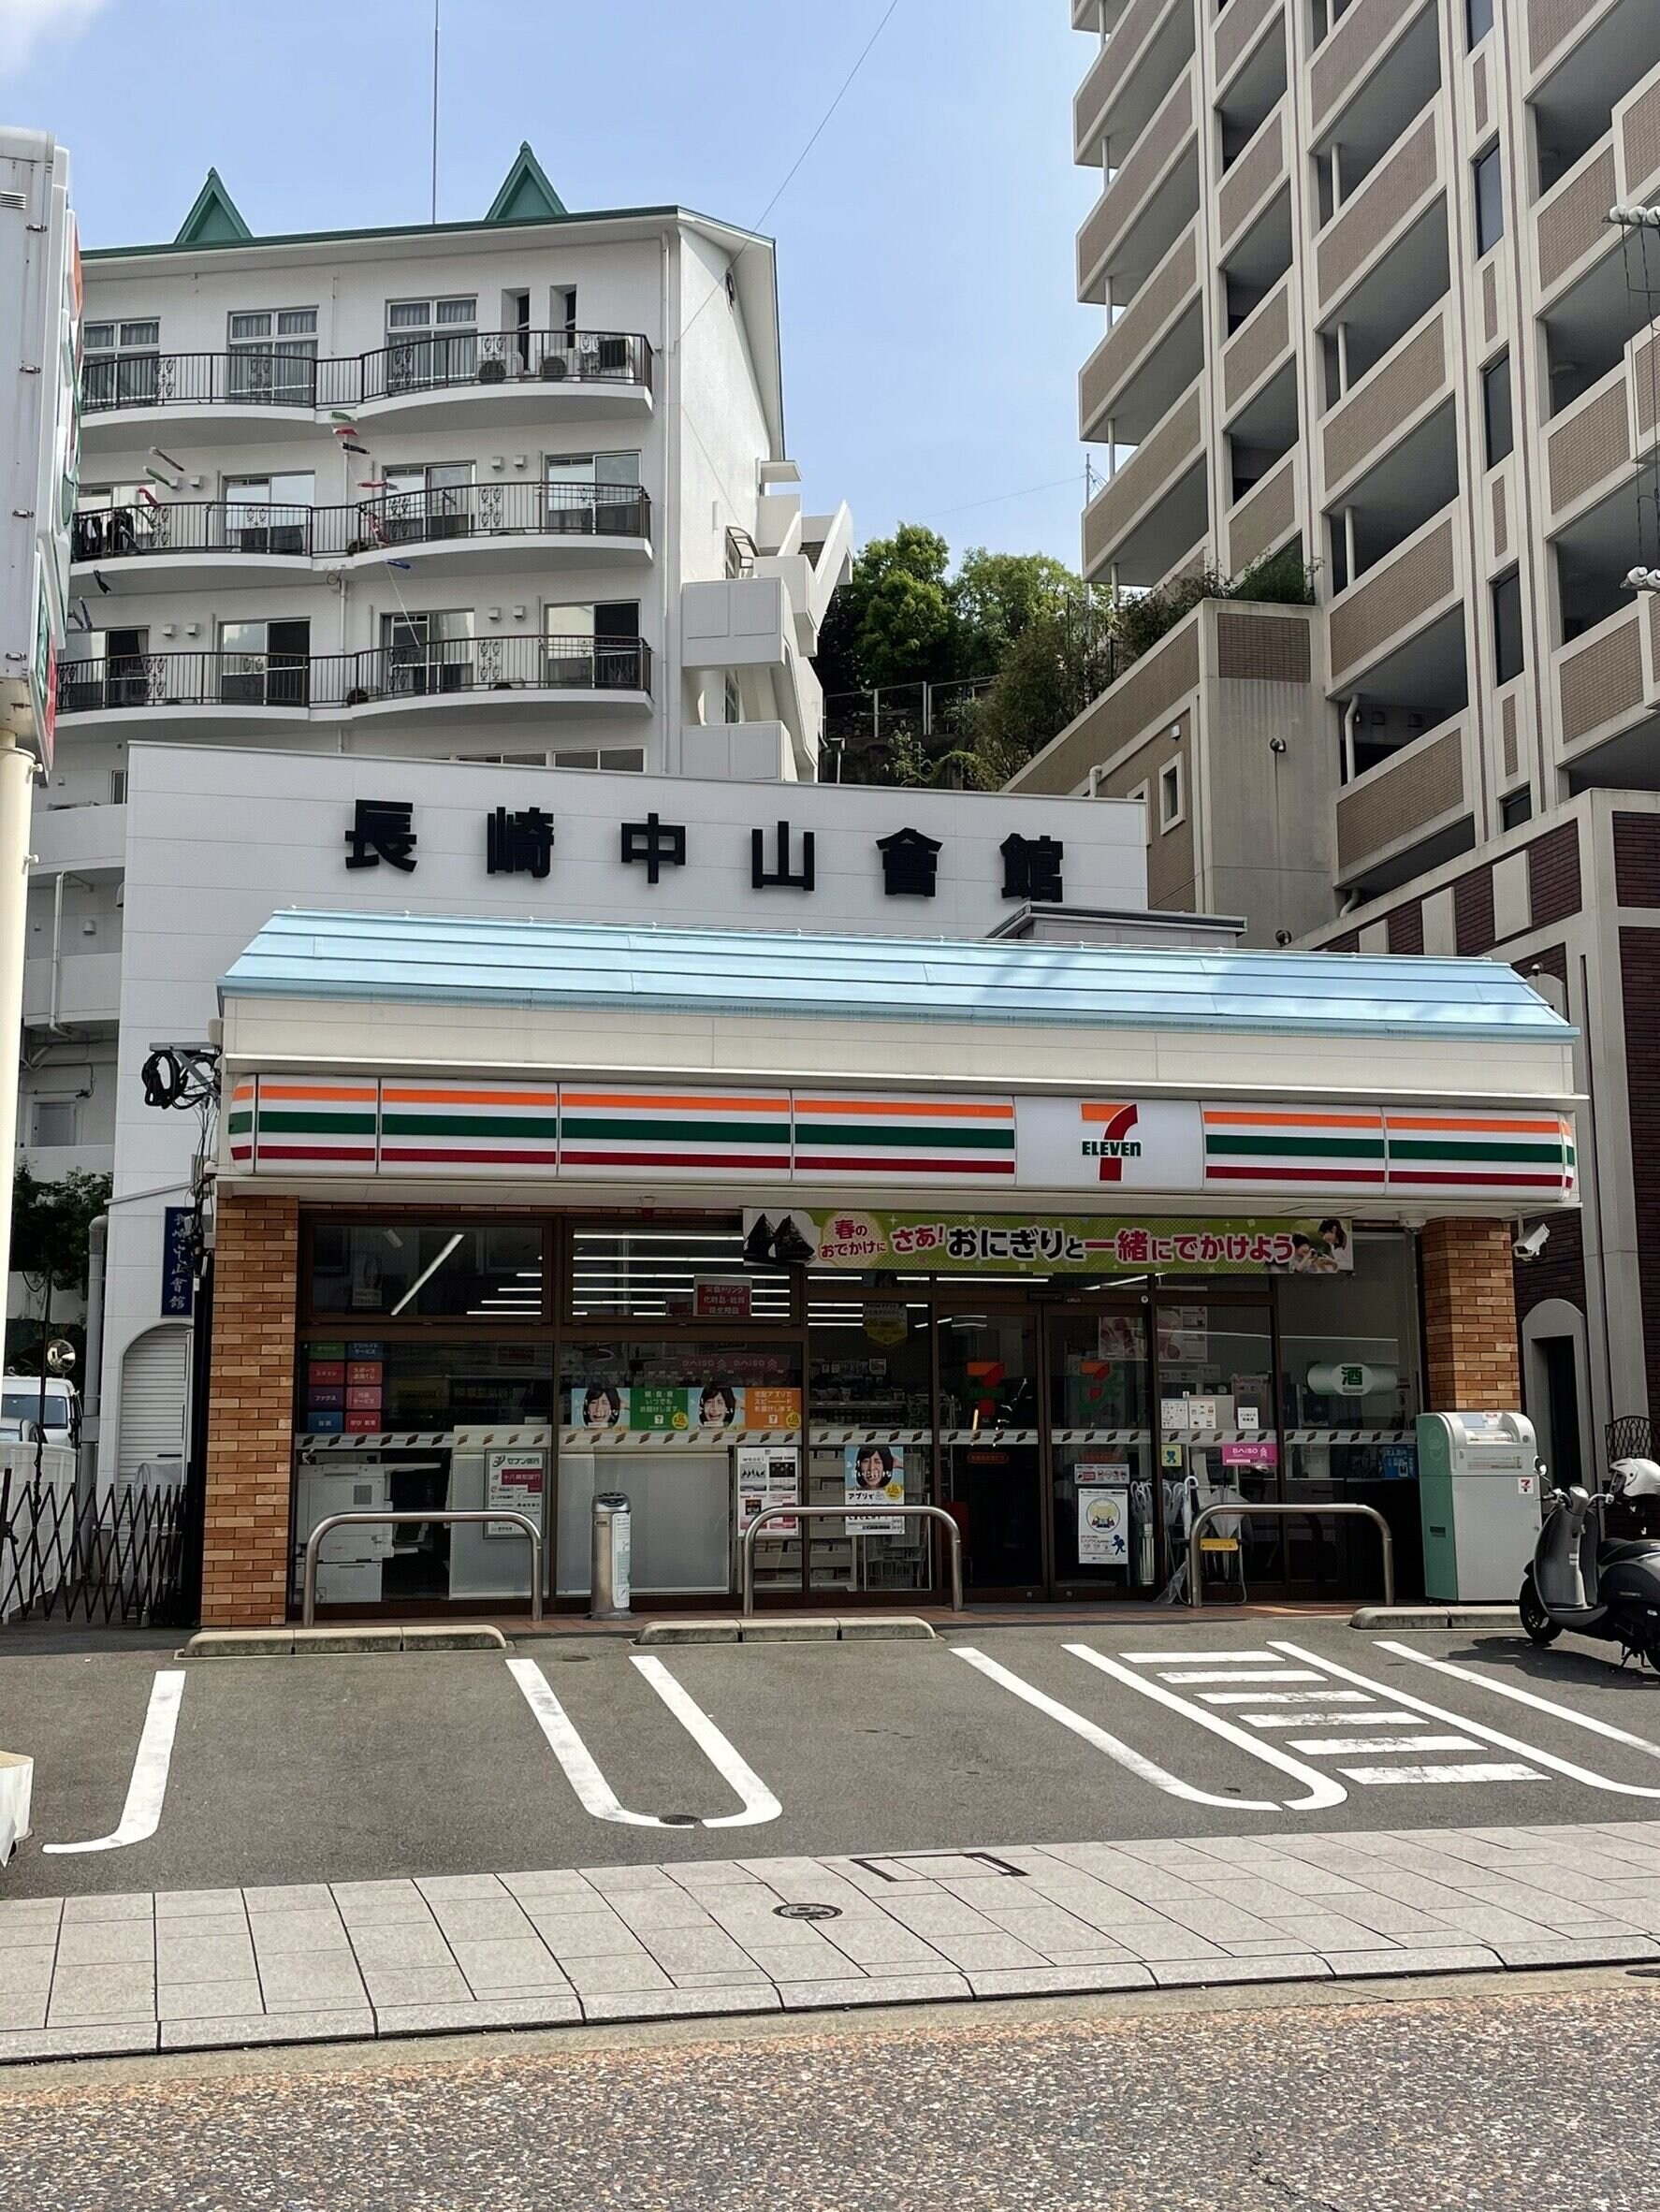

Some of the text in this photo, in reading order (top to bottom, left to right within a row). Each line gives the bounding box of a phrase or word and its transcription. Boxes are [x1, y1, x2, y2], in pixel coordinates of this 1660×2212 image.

[344, 798, 1065, 903] 長崎中山會館
[834, 1218, 868, 1240] 春の
[820, 1240, 887, 1259] おでかけに
[1340, 1365, 1363, 1386] 酒
